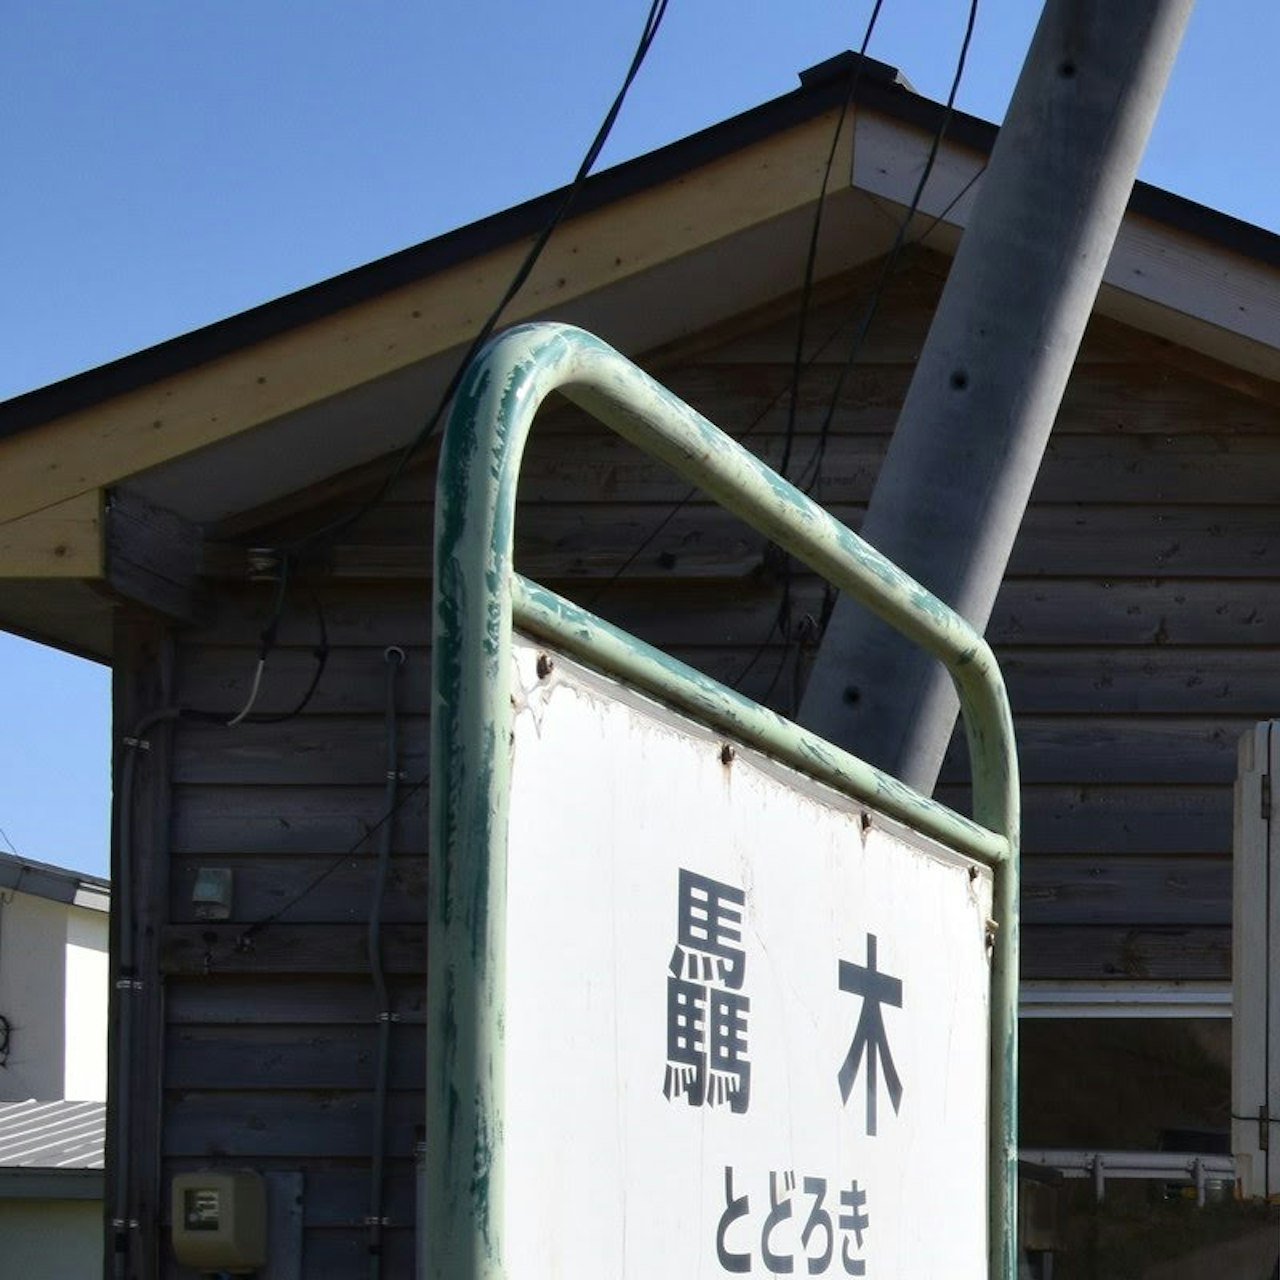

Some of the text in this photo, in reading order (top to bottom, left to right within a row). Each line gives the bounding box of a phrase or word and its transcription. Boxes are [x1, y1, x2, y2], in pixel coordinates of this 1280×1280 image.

[663, 867, 904, 1137] 驫木
[715, 1165, 870, 1277] とどろき
